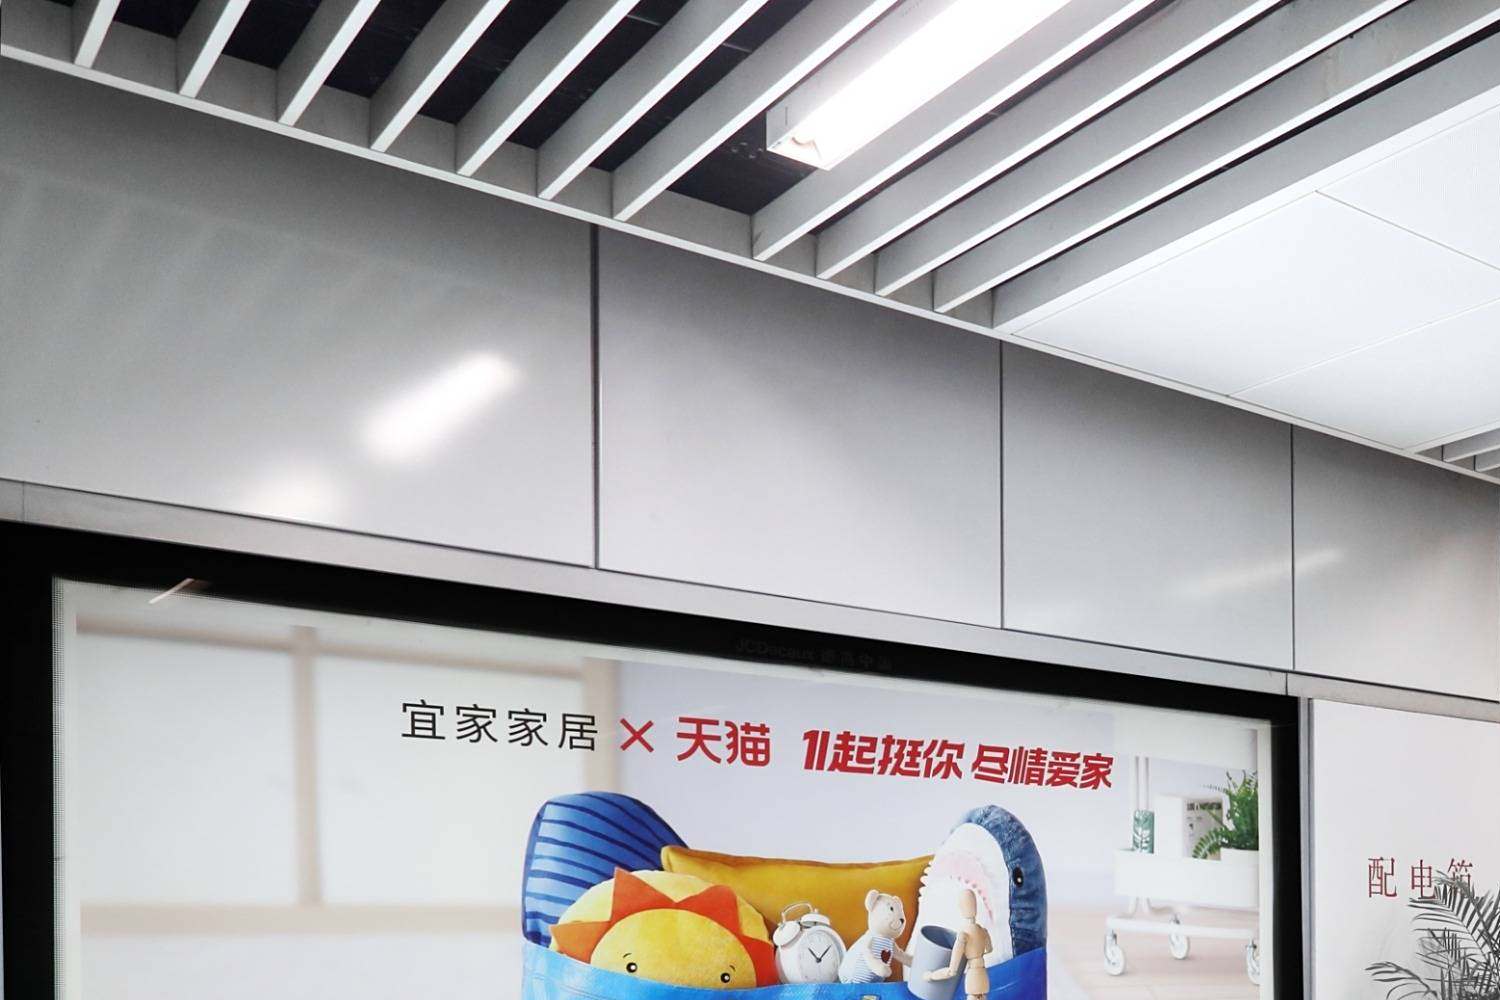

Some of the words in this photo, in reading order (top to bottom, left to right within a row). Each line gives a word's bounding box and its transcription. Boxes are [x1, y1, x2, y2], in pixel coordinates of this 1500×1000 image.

[402, 698, 598, 752] 宜家家居
[676, 715, 771, 768] 天猫
[971, 743, 1114, 790] 尽情爱家
